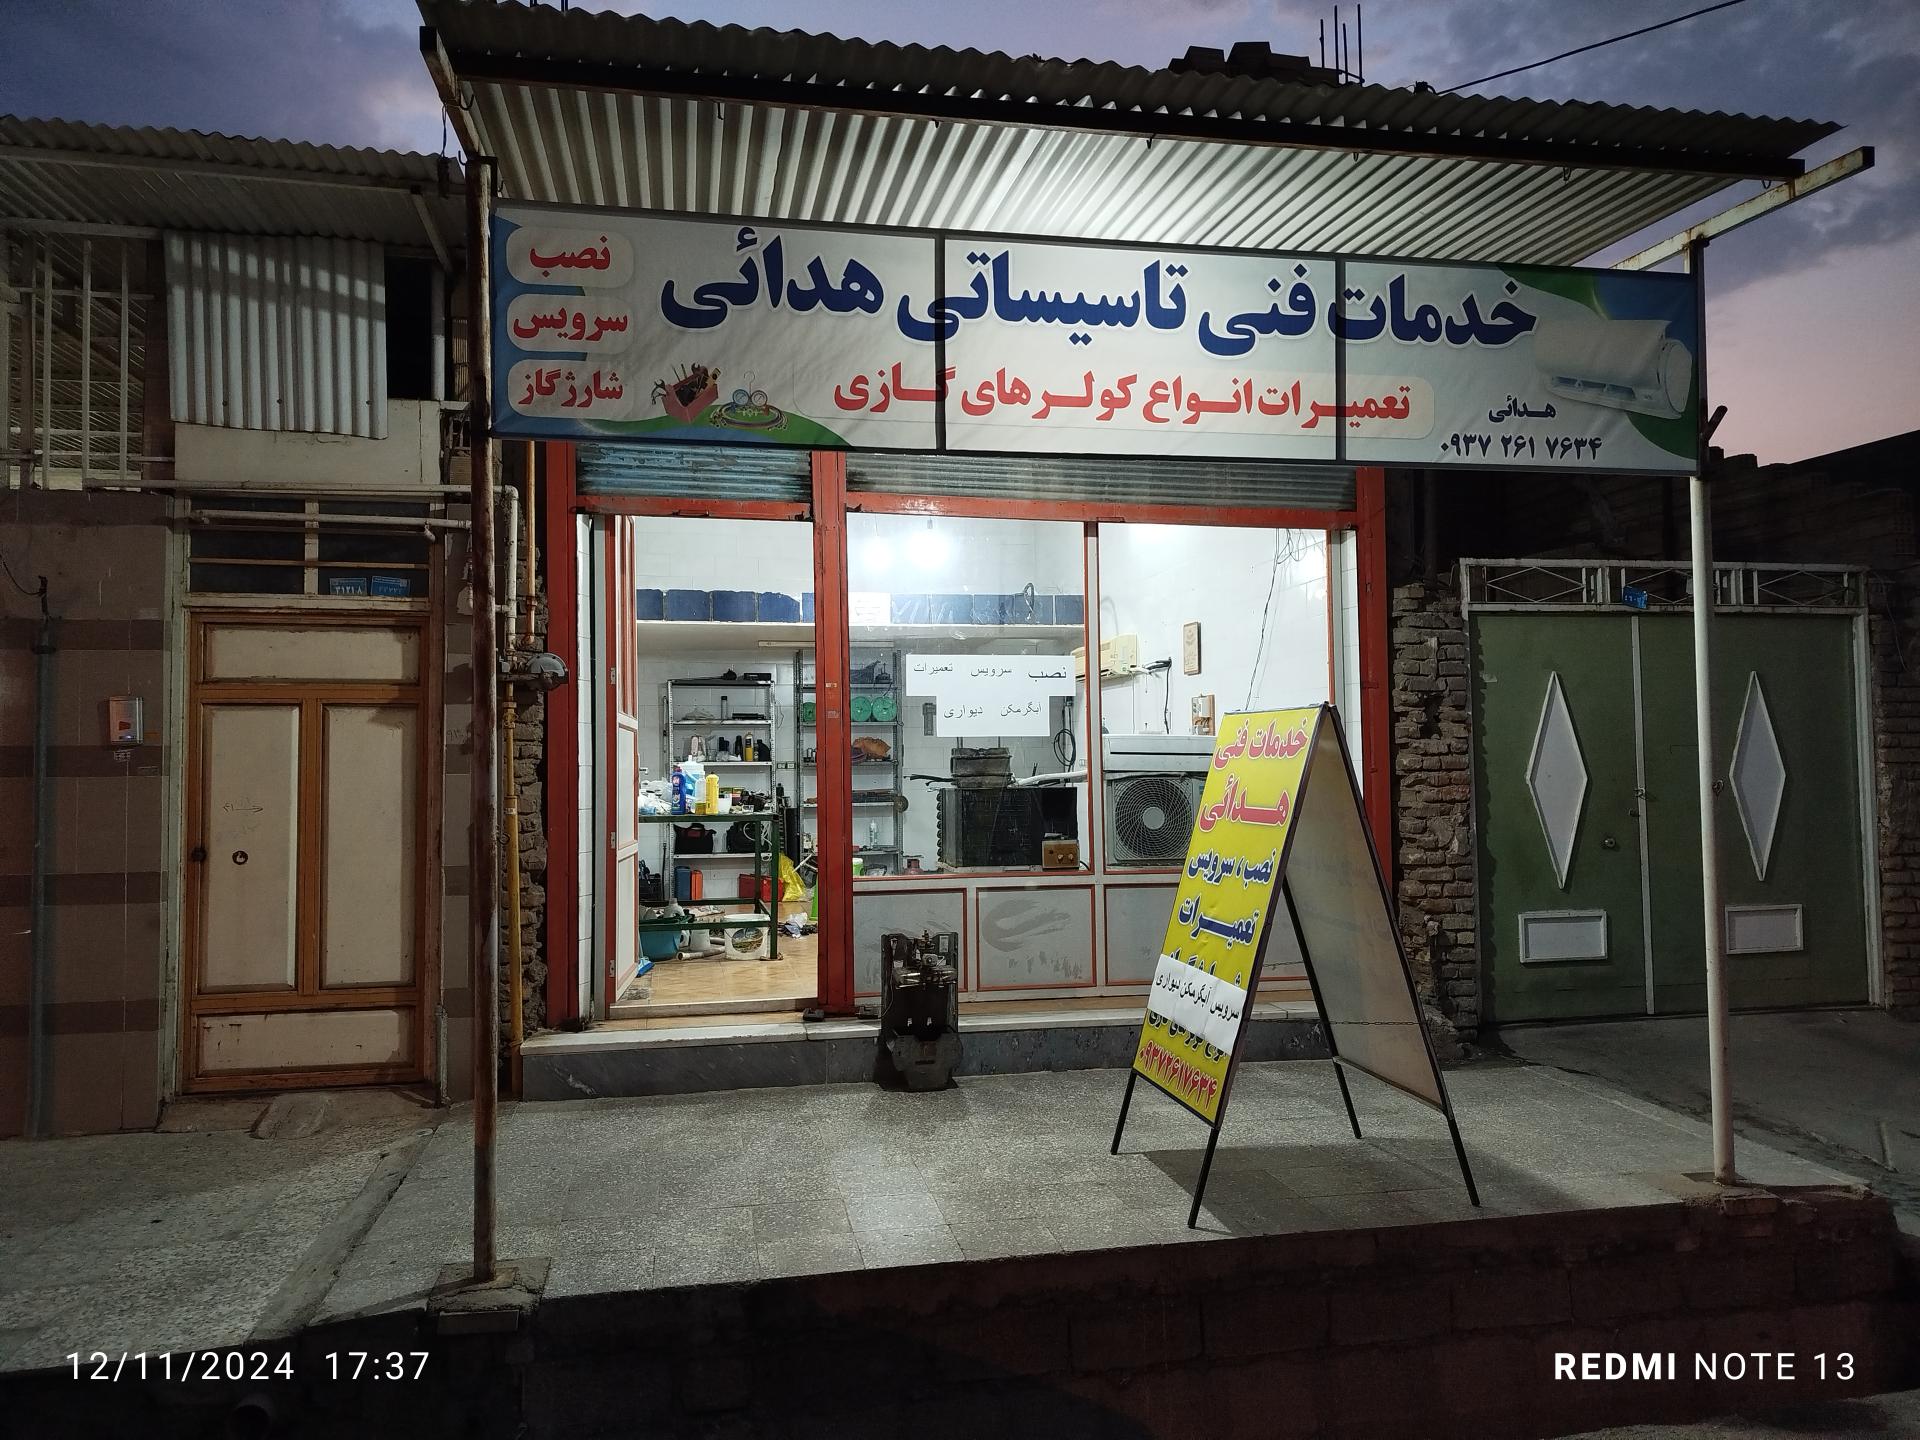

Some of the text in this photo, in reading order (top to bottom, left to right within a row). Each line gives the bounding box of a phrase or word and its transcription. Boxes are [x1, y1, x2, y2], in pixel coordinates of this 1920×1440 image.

[528, 234, 611, 277] نصب
[660, 226, 1537, 356] خدمات فنی تاسیساتی هدائی
[513, 305, 628, 342] سرویس
[834, 361, 957, 413] گازی
[1142, 375, 1252, 425] انواع
[1257, 380, 1411, 429] تعمیرات
[1488, 395, 1557, 423] هدائی
[1440, 433, 1602, 460] ۰۹۳۷ ۲۶۱ ۷۶۳۴
[913, 662, 1067, 682] نصب سرویس تعمیرات
[943, 704, 983, 718] دیواری
[1214, 717, 1309, 769] خدمات فنی
[1188, 848, 1236, 885] سرویس
[1179, 893, 1260, 950] تعمیرات
[1156, 972, 1181, 993] دیواری
[1209, 1001, 1240, 1022] سرویس
